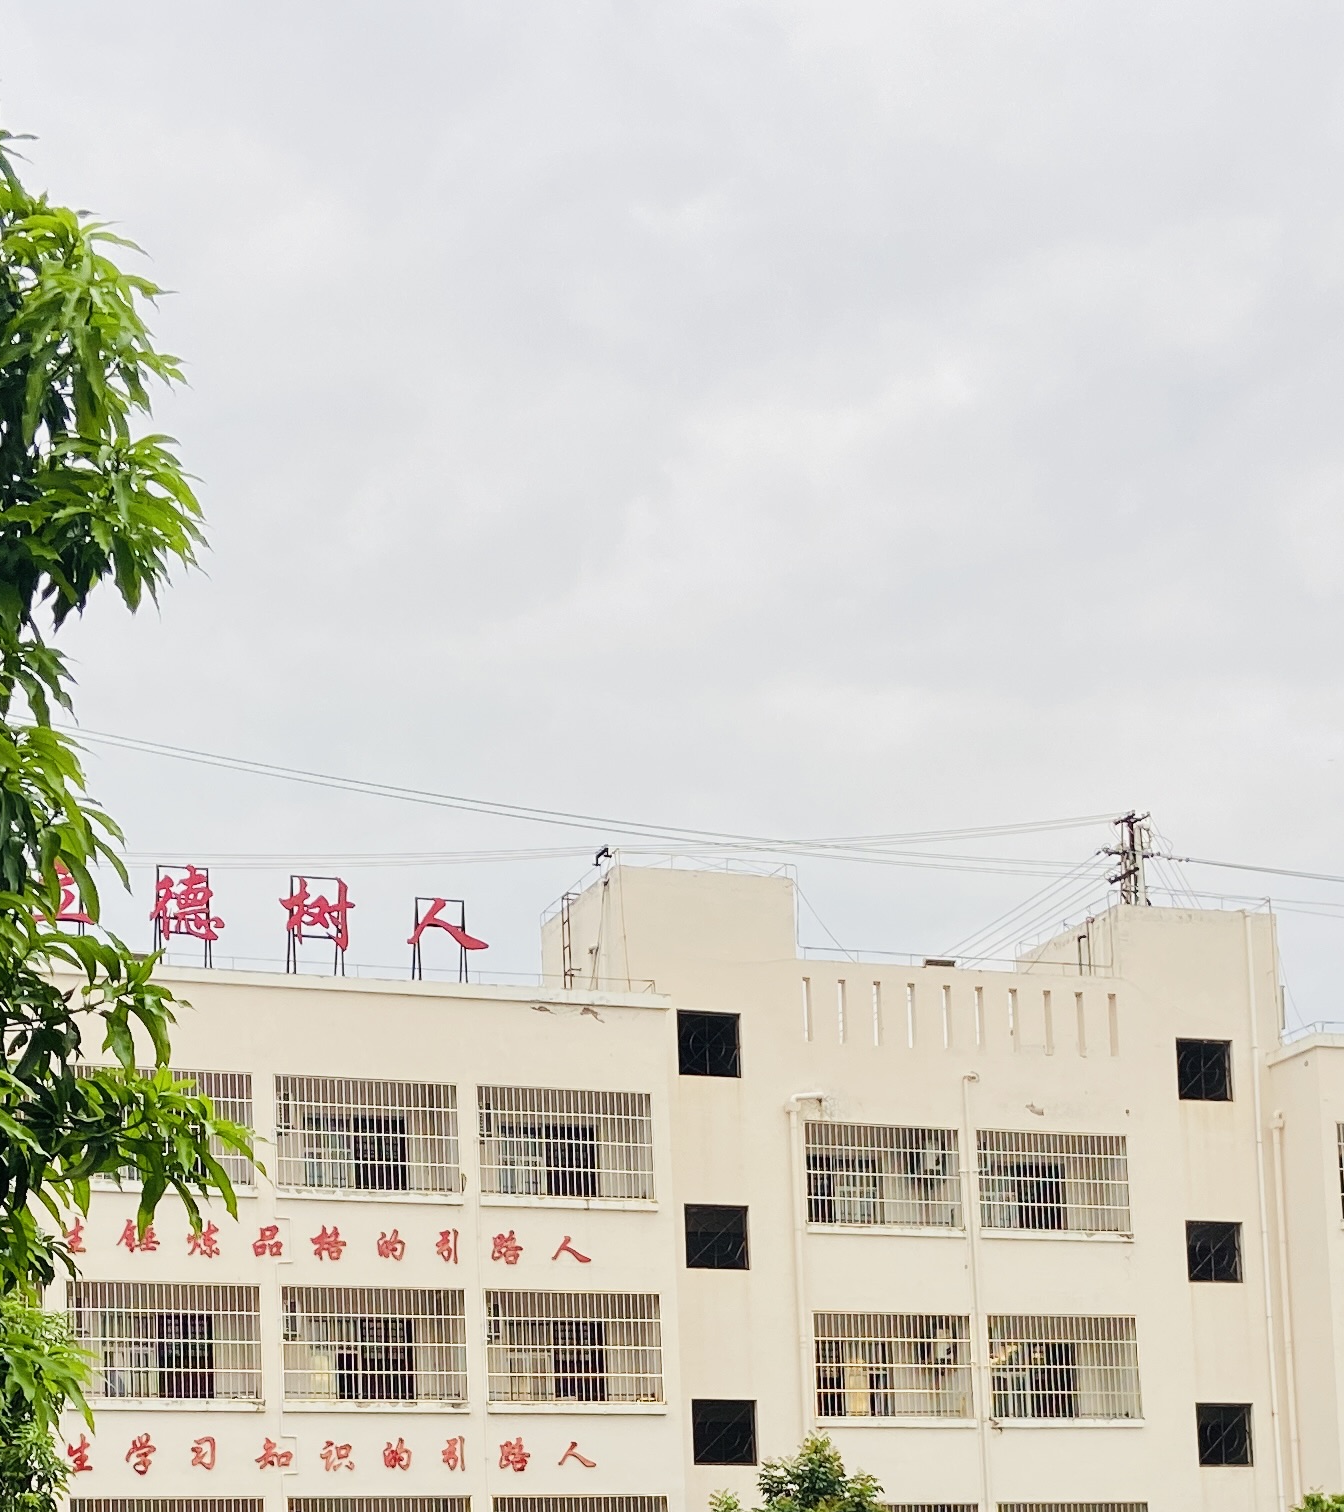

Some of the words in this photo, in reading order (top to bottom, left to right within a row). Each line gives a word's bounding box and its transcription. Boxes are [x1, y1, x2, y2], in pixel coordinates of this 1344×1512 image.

[66, 1433, 597, 1475] 生学习知识的引路人
